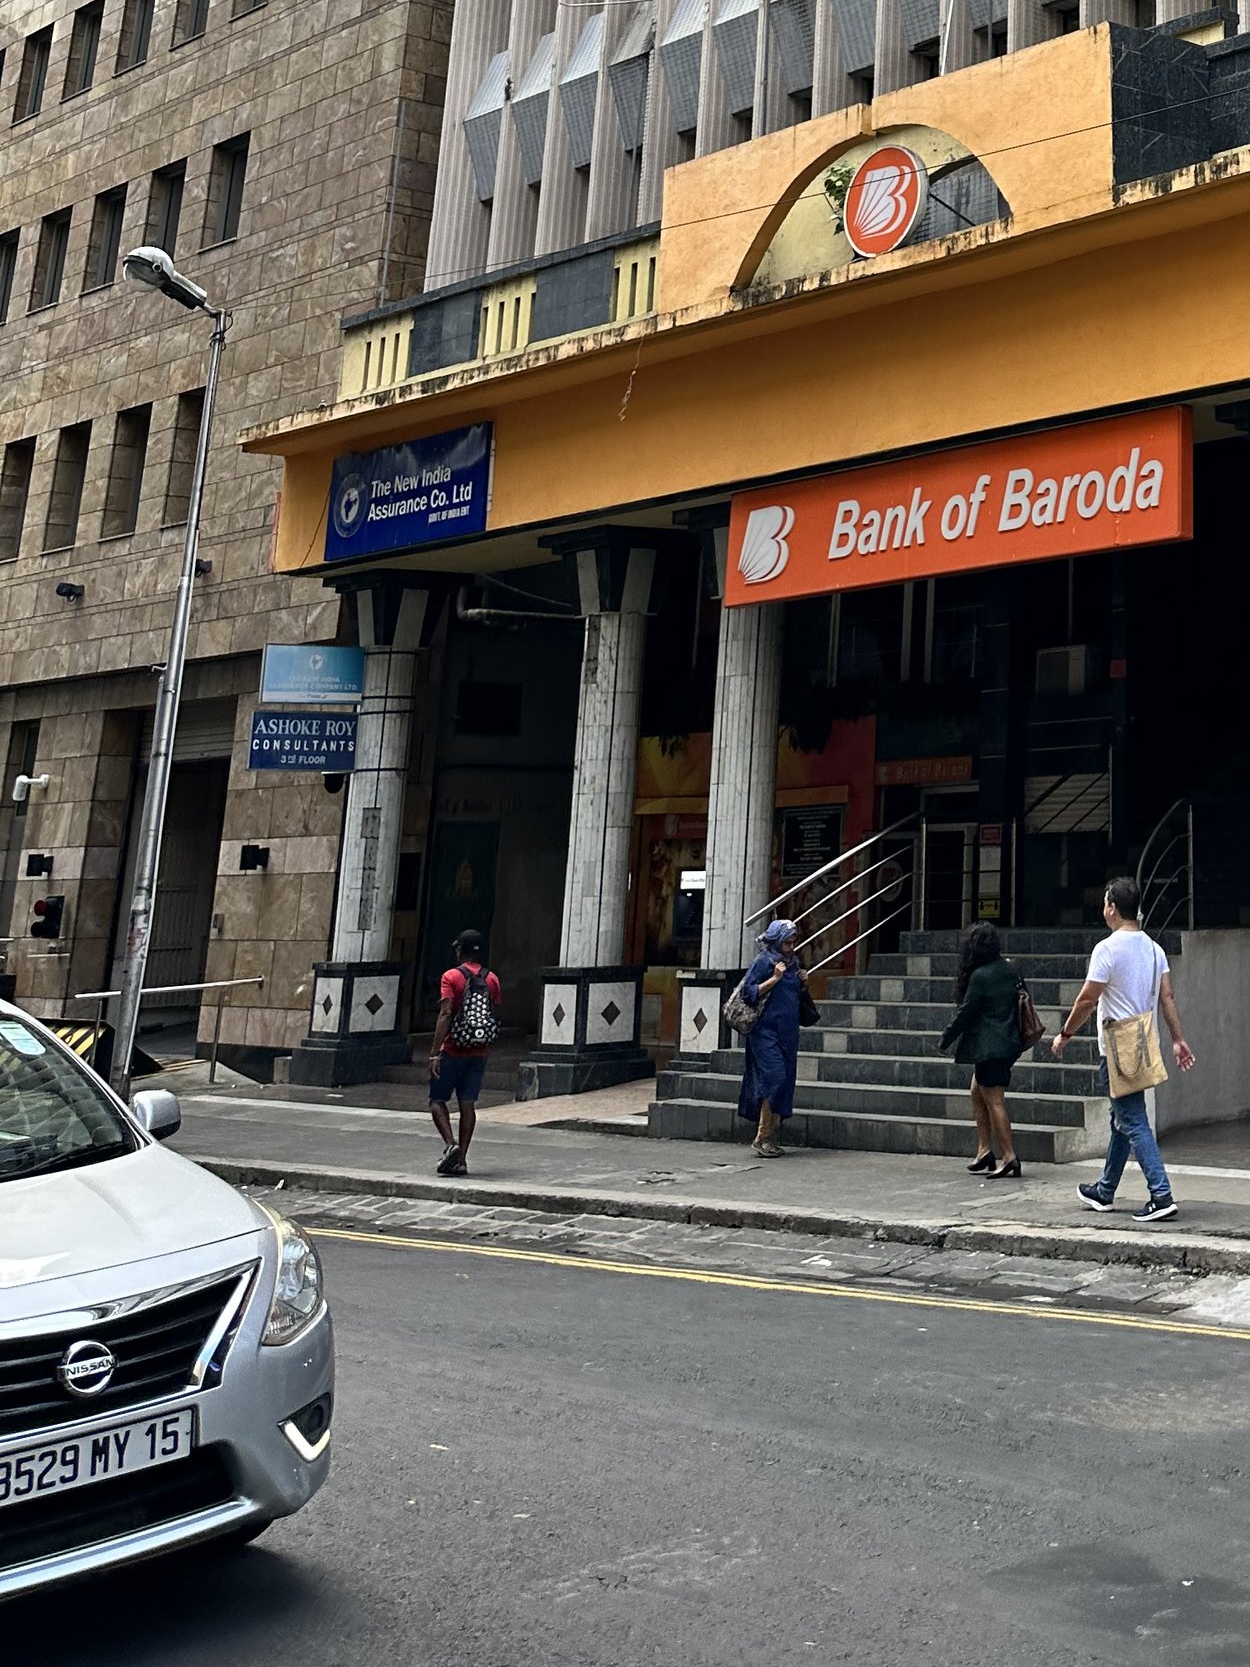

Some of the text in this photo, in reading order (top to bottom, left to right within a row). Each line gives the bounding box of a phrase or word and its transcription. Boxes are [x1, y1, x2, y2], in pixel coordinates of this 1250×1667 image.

[370, 466, 451, 499] The New India
[367, 481, 473, 522] Assurance Co. Ltd
[828, 447, 1164, 559] Bank of Baroda
[254, 718, 356, 736] ASHOKE ROY
[252, 739, 355, 751] CONSULTANTS
[299, 755, 326, 764] FLOOR
[66, 1358, 115, 1377] NISSAN
[90, 1429, 131, 1477] MY
[145, 1416, 180, 1460] 15
